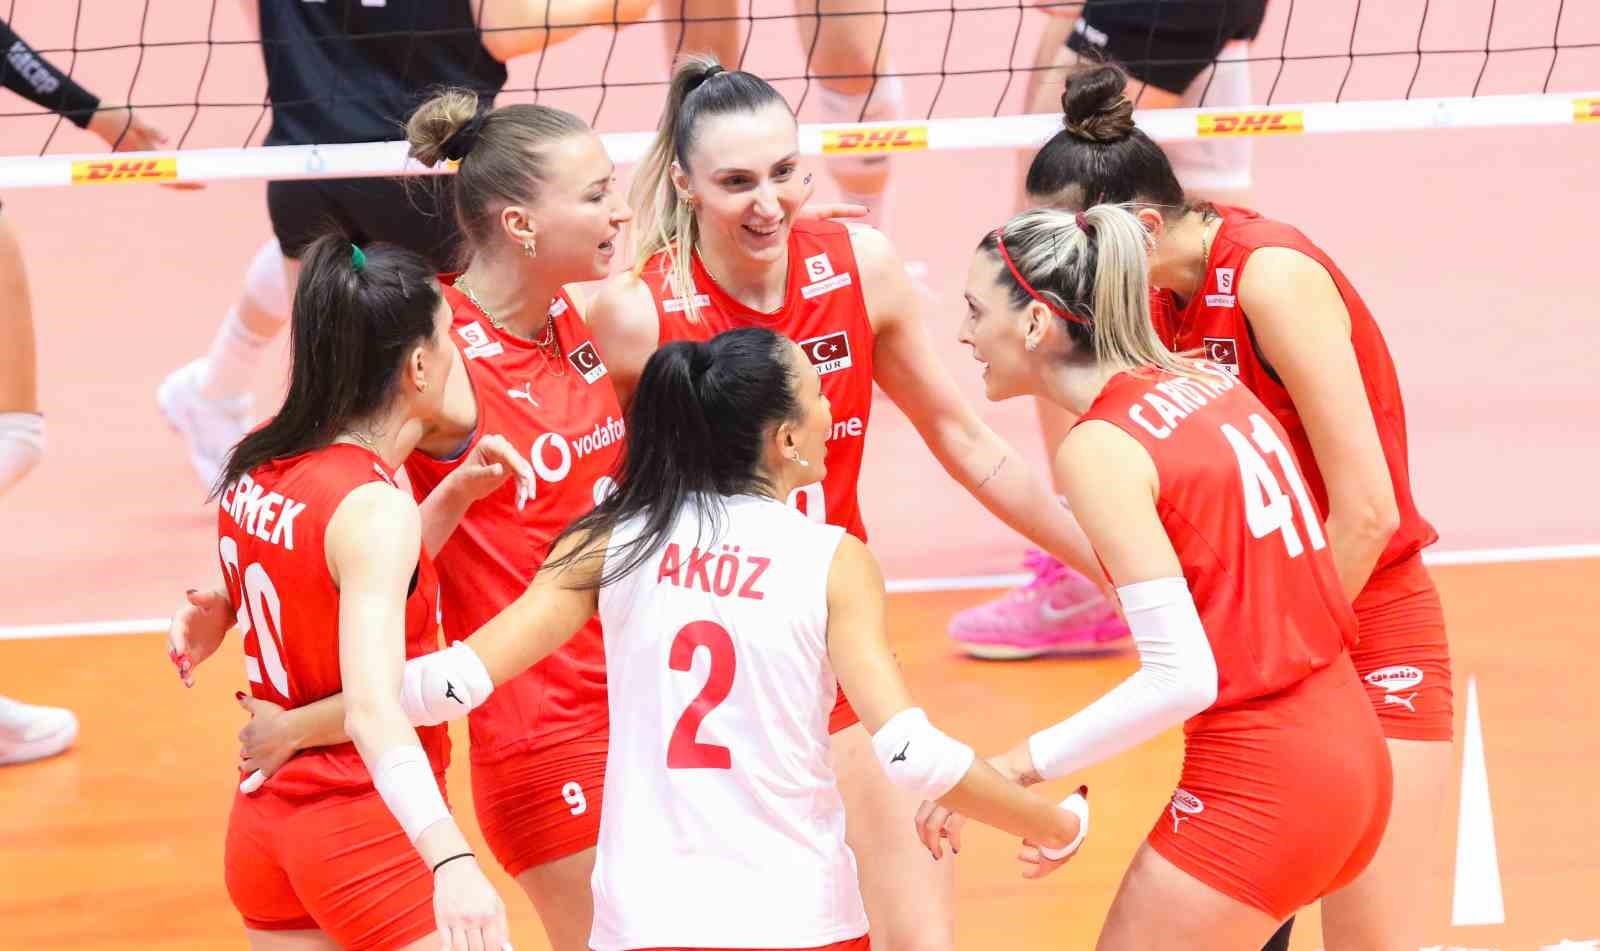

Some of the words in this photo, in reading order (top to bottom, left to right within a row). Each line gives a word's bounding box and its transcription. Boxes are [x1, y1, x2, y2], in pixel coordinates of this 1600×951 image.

[1213, 114, 1289, 133] DHL
[838, 131, 915, 149] DHL
[86, 160, 164, 180] DHL
[812, 261, 826, 275] S
[1222, 273, 1231, 288] S
[465, 330, 479, 344] S
[1220, 414, 1326, 559] 41
[657, 543, 771, 601] AKÖZ
[219, 535, 289, 698] 20
[666, 620, 736, 769] 2
[561, 781, 588, 816] 9
